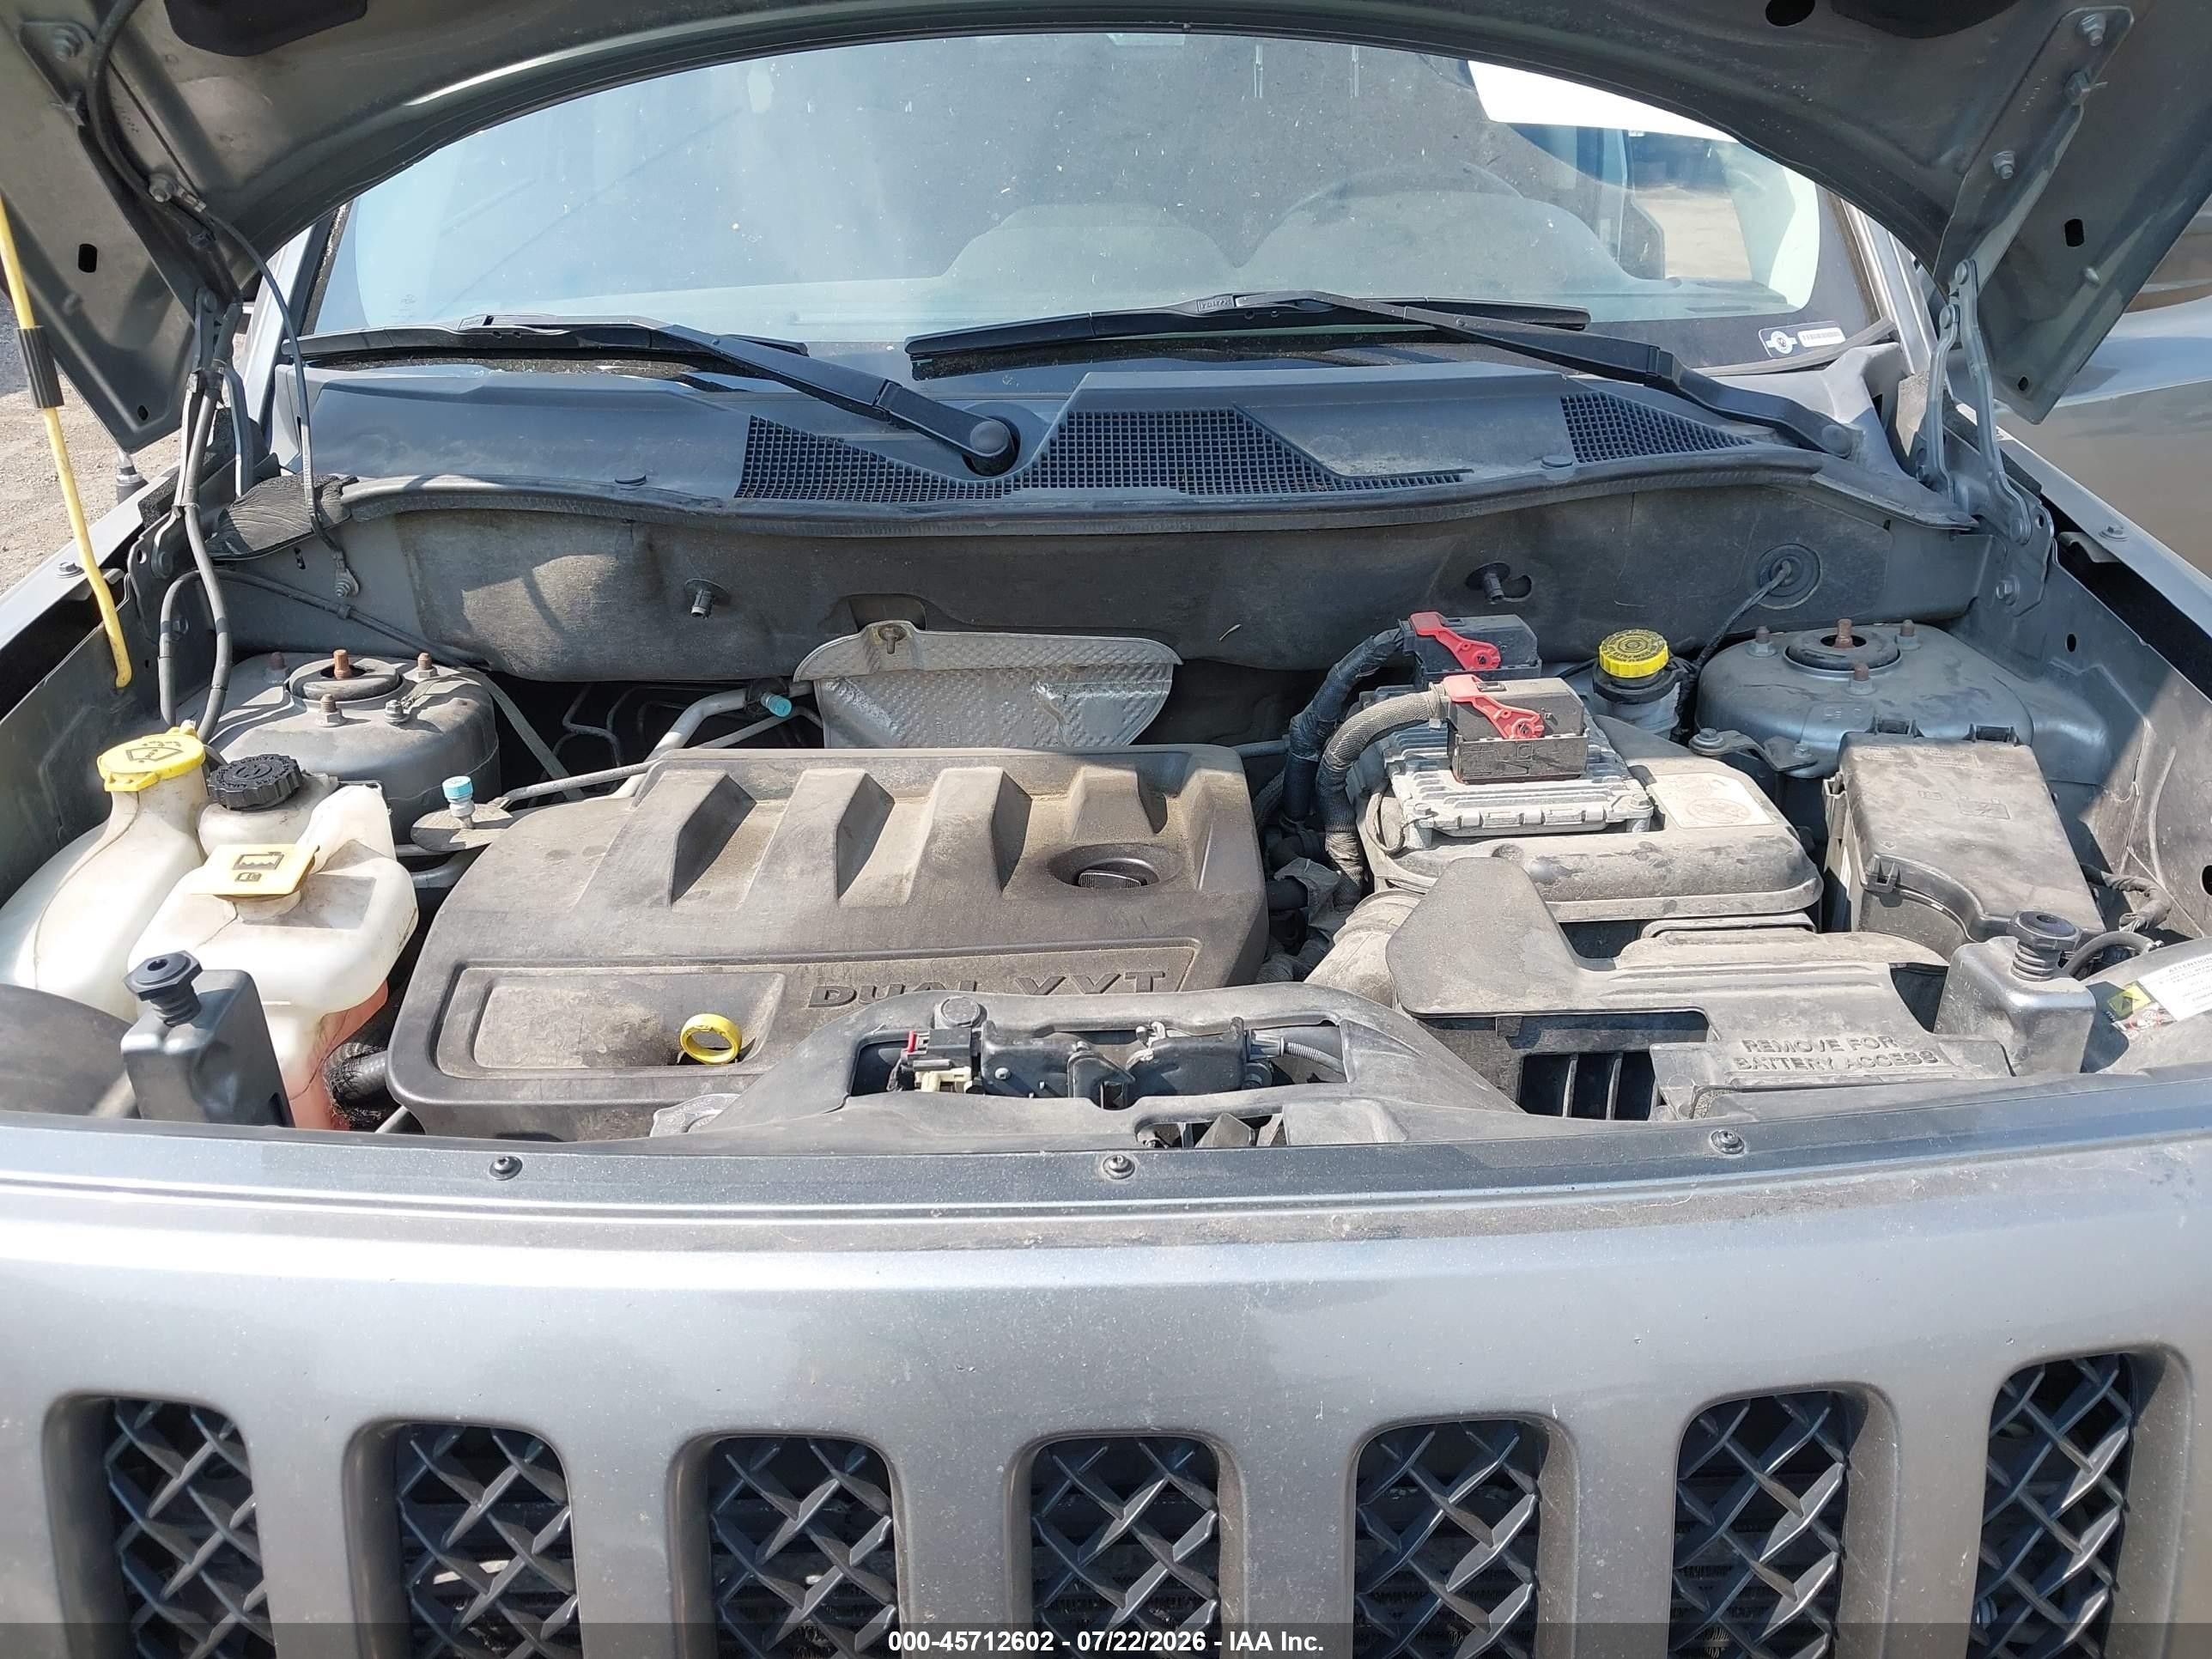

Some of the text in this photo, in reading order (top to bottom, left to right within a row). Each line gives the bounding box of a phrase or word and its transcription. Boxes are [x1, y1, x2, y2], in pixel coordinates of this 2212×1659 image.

[1741, 1036, 1899, 1053] REMOVE FOR
[1732, 1056, 1835, 1071] BATTERY
